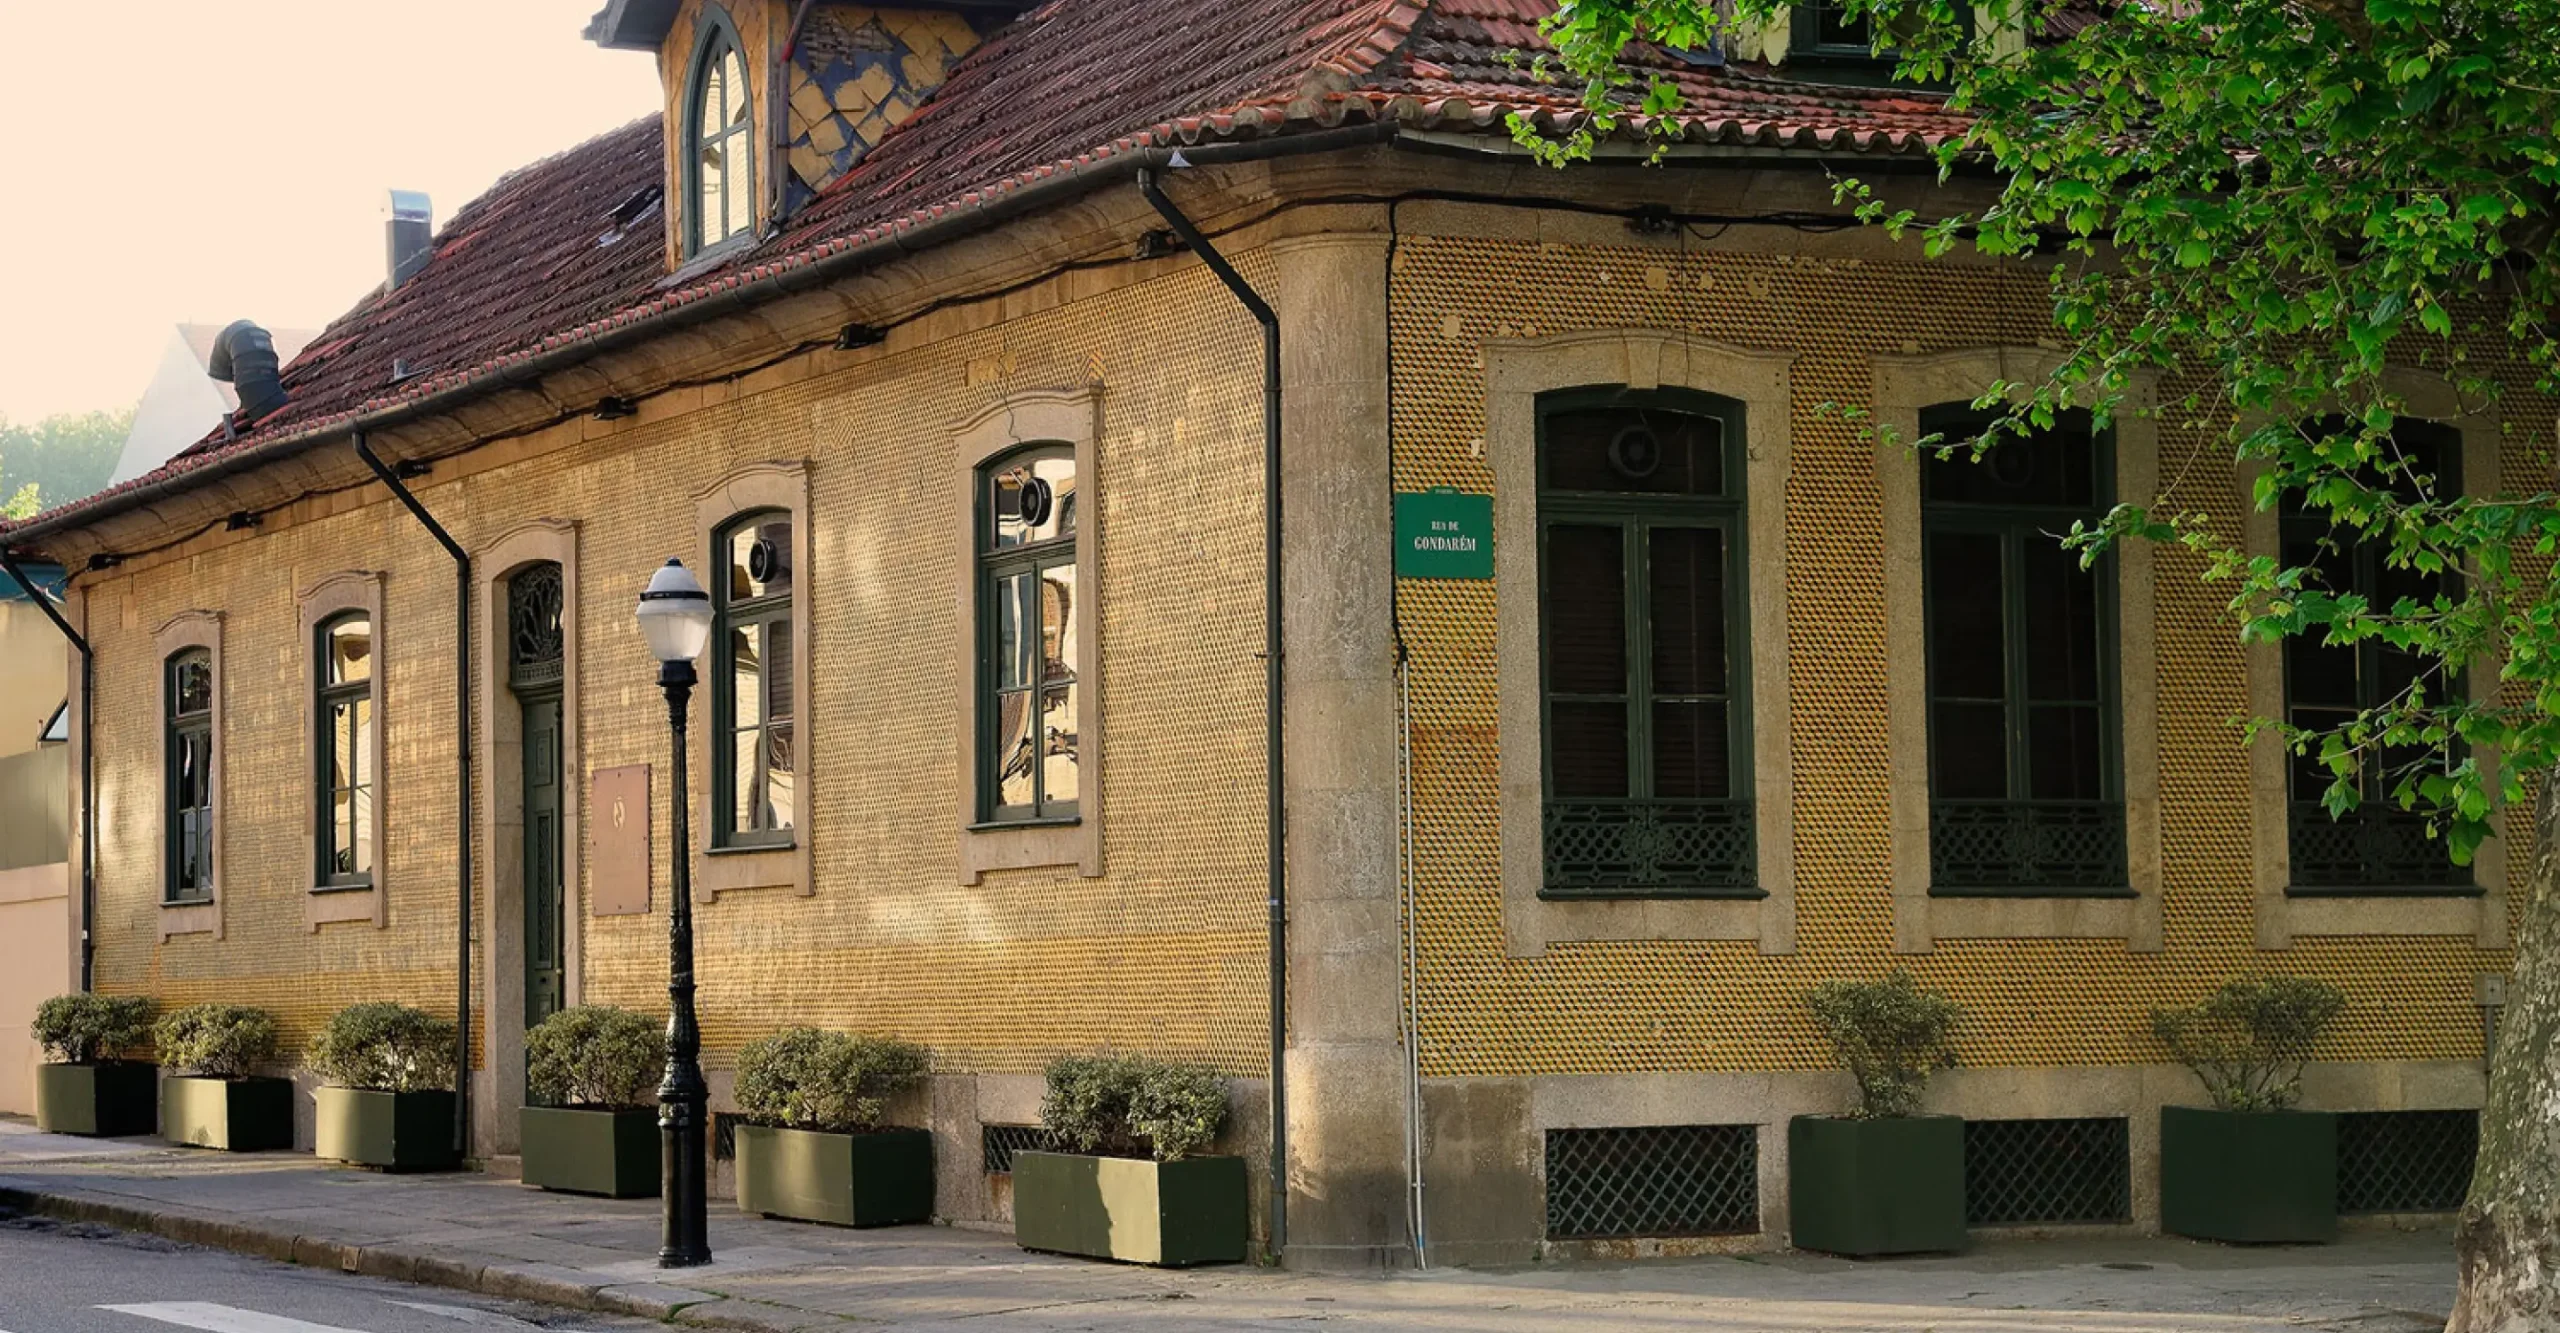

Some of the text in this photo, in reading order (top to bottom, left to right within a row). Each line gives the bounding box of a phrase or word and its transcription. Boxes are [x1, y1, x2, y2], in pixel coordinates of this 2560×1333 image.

[1431, 521, 1459, 531] RUA DE
[1414, 534, 1476, 551] GONDARÉM
